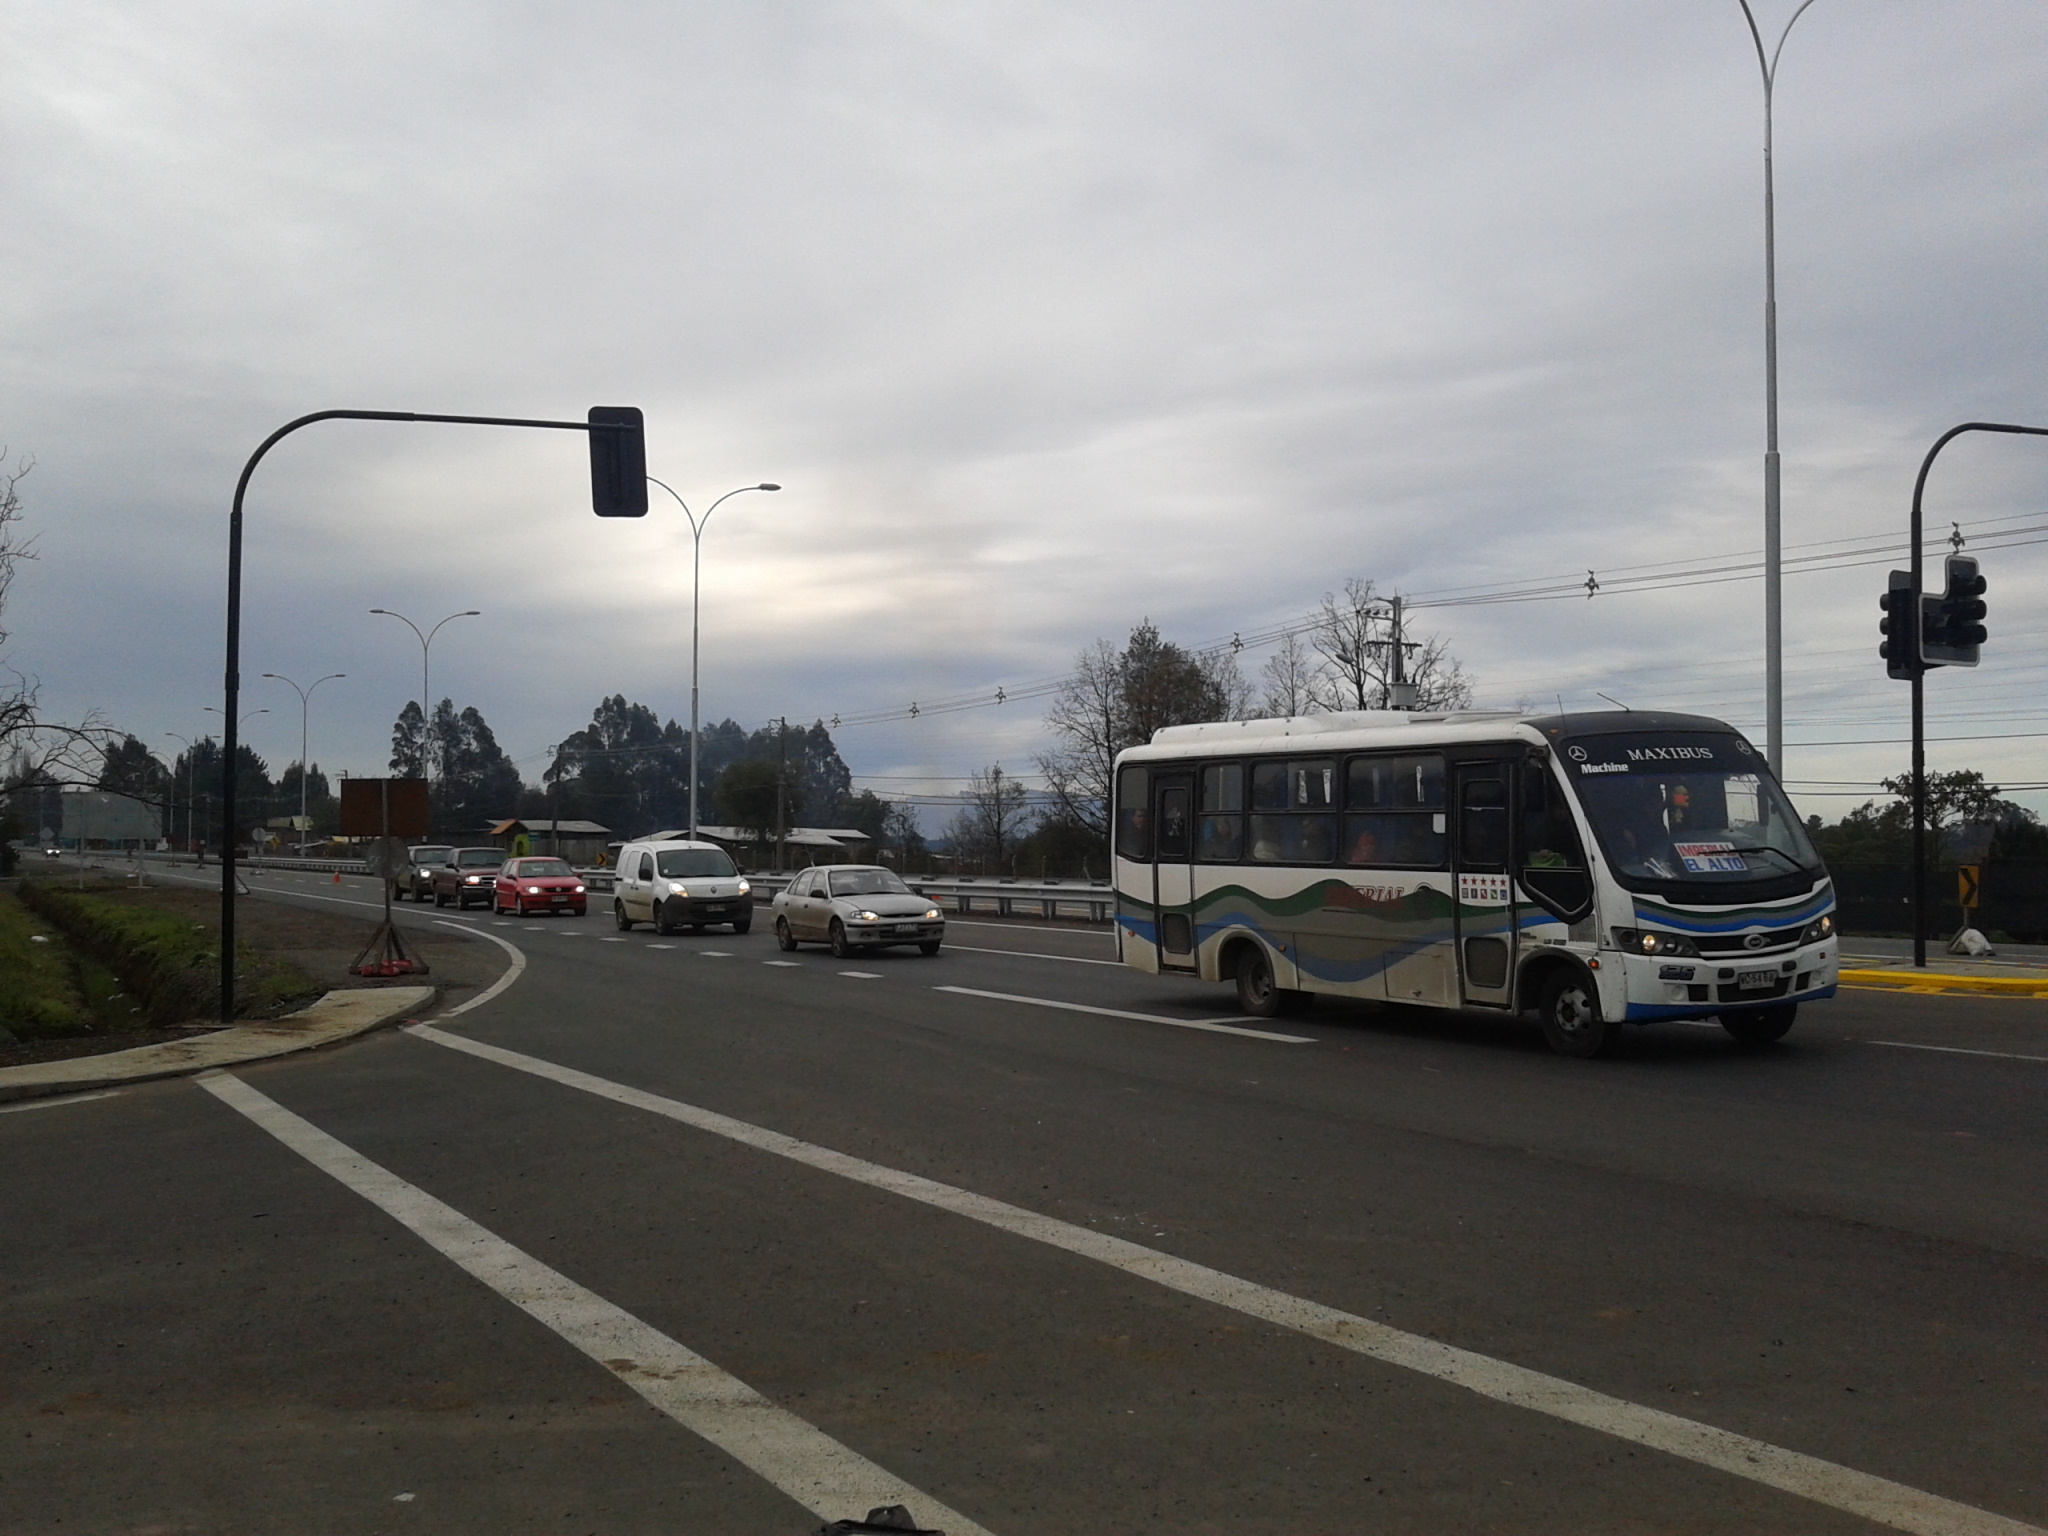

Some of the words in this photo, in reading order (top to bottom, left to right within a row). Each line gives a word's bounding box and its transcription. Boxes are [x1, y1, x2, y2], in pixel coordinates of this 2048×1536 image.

[1627, 747, 1713, 760] MAXIBUS
[1580, 762, 1629, 774] Machine
[1683, 858, 1704, 871] EL
[1708, 857, 1745, 871] ALTO
